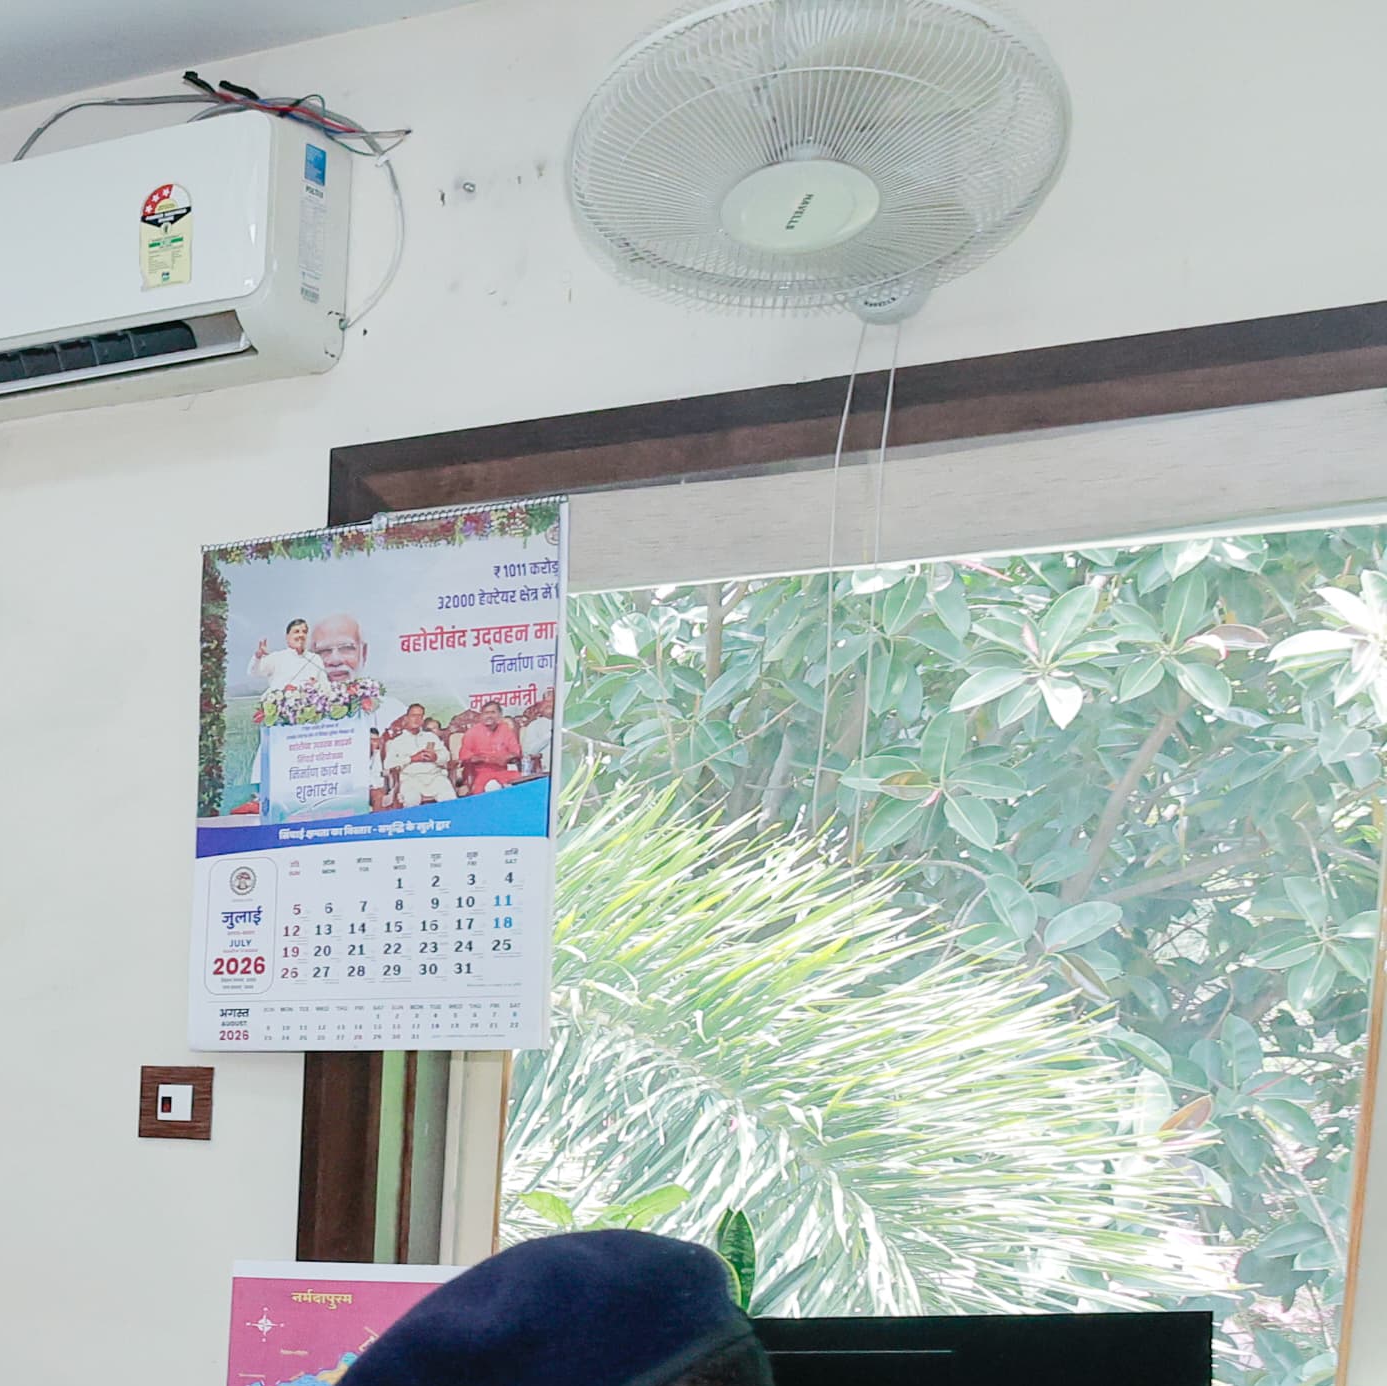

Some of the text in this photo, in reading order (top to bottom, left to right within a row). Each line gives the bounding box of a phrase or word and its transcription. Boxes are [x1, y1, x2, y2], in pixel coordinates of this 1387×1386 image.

[785, 193, 814, 230] HAVELLS
[504, 563, 526, 578] 1011
[437, 593, 475, 610] 32000
[478, 588, 516, 606] हेक्टेयर
[519, 585, 538, 601] क्षेत्र
[542, 583, 554, 599] में
[399, 625, 468, 653] बहोरीबंद
[471, 623, 530, 651] उद्वहन
[491, 652, 534, 674] निर्माण
[289, 764, 319, 780] निर्माण
[295, 781, 339, 803] शुभारंभ
[396, 872, 514, 889] 1 2 3 4
[292, 894, 513, 915] 5 6 7 8 9 10 11
[221, 905, 263, 929] जुलाई
[283, 916, 513, 937] 12 13 14 15 16 17 18
[229, 938, 252, 948] JULY
[282, 939, 512, 958] 19 20 21 22 23 24 25
[213, 956, 265, 976] 2026
[281, 962, 472, 979] 26 27 28 29 30 31
[219, 1008, 250, 1018] अगस्त
[219, 1030, 250, 1041] 2026
[290, 1288, 353, 1310] नर्मदापुरम
